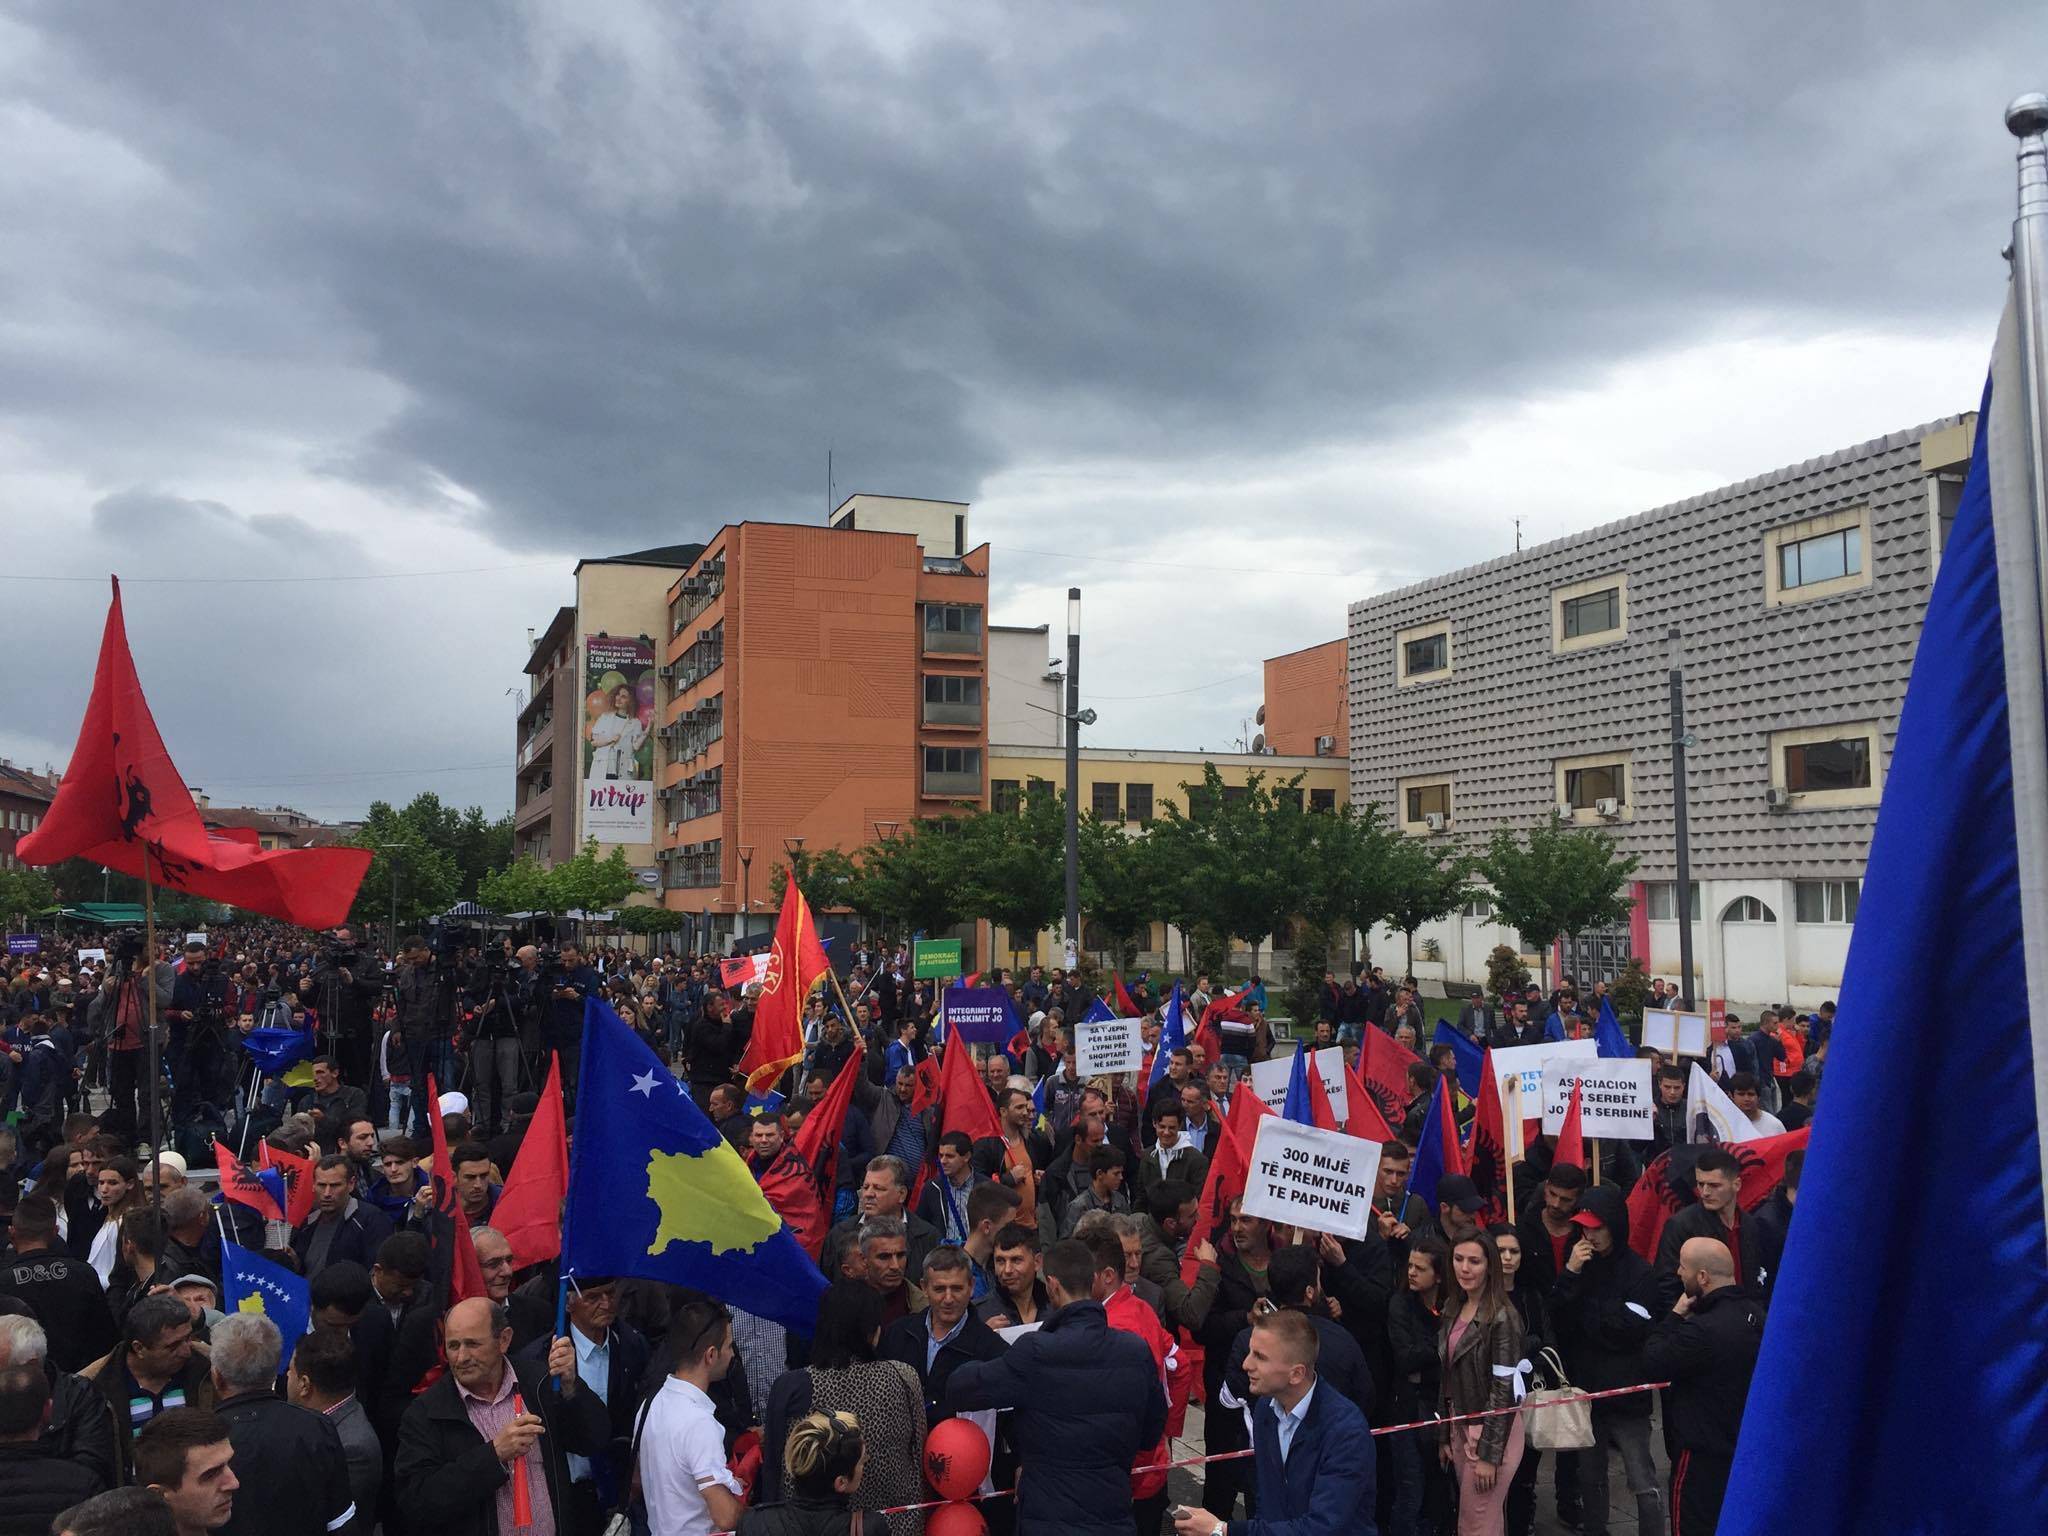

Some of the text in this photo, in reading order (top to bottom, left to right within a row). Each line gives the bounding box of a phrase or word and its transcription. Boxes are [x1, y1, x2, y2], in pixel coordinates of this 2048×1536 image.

[590, 784, 647, 817] n'trip
[920, 952, 958, 960] DEMOKRACI
[948, 1014, 990, 1023] MASKIMIT
[1104, 1033, 1129, 1041] SERBËT
[1089, 1051, 1130, 1060] SHQIPTARËT
[1521, 1083, 1537, 1092] JO
[1559, 1078, 1637, 1090] ASOCIACION
[1588, 1092, 1637, 1104] SERBËT
[1549, 1105, 1564, 1115] JO
[1595, 1107, 1649, 1119] SERBINË
[1282, 1147, 1350, 1174] 300 MIJË
[1260, 1161, 1366, 1198] TË PREMTUAR
[1268, 1184, 1350, 1215] TE PAPUNË
[13, 1261, 68, 1284] D&G
